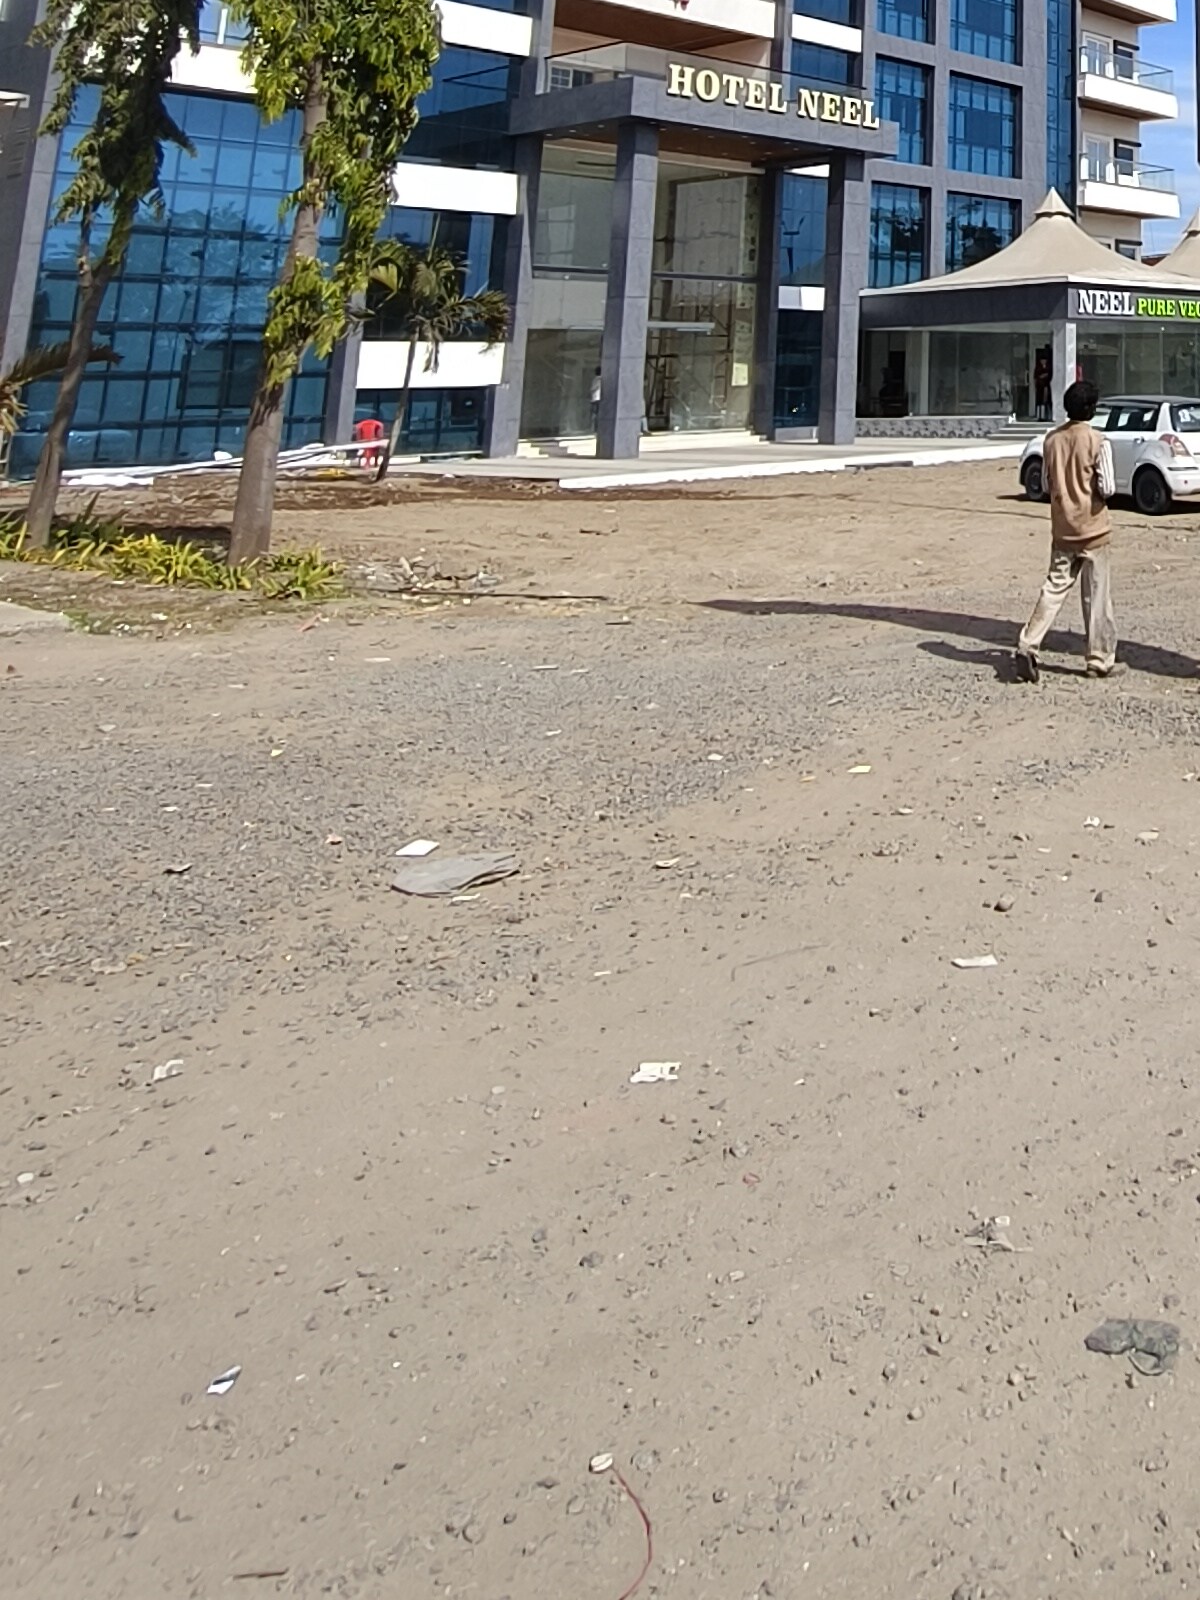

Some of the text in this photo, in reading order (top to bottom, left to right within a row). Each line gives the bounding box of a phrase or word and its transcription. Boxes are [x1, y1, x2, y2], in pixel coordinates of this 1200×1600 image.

[667, 63, 880, 130] HOTEL NEEL
[1078, 289, 1135, 315] NEEL
[1137, 297, 1176, 316] PURE
